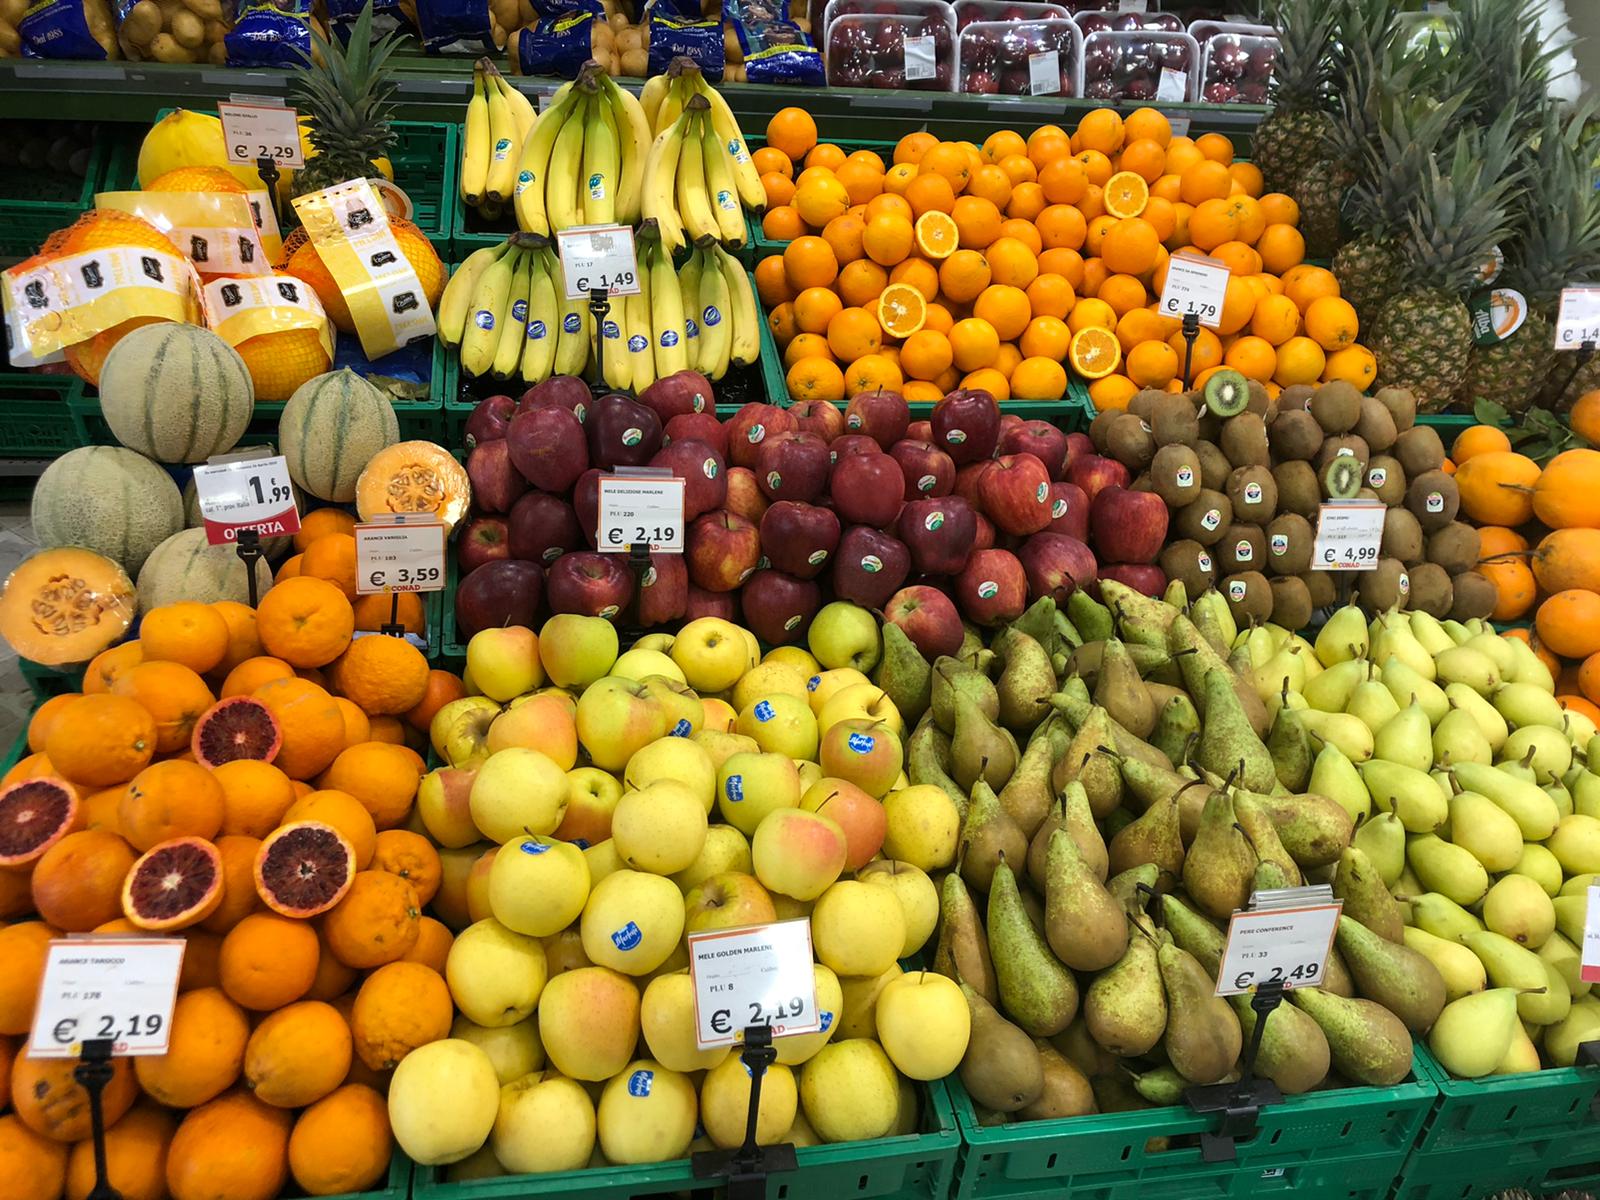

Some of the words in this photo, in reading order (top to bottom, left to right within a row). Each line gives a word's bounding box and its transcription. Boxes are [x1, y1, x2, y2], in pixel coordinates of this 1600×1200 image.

[234, 145, 249, 158] €
[258, 145, 294, 159] 2,29
[577, 278, 590, 292] €
[600, 272, 634, 289] 1,49
[1167, 298, 1179, 311] €
[1187, 301, 1216, 317] 1,79
[223, 521, 285, 540] OFRTA
[608, 528, 623, 544] €
[635, 527, 675, 544] 2,19
[1324, 548, 1336, 562] €
[1345, 547, 1376, 562] 4,99
[370, 571, 386, 587] €
[398, 568, 439, 584] 3,59
[698, 952, 715, 961] MELE
[716, 948, 742, 958] GOLDEN
[1234, 971, 1255, 989] €
[1268, 963, 1319, 983] 2,49
[710, 1009, 733, 1034] €
[748, 997, 805, 1028] 2,19
[53, 1018, 78, 1044] €
[97, 1014, 163, 1041] 2,19
